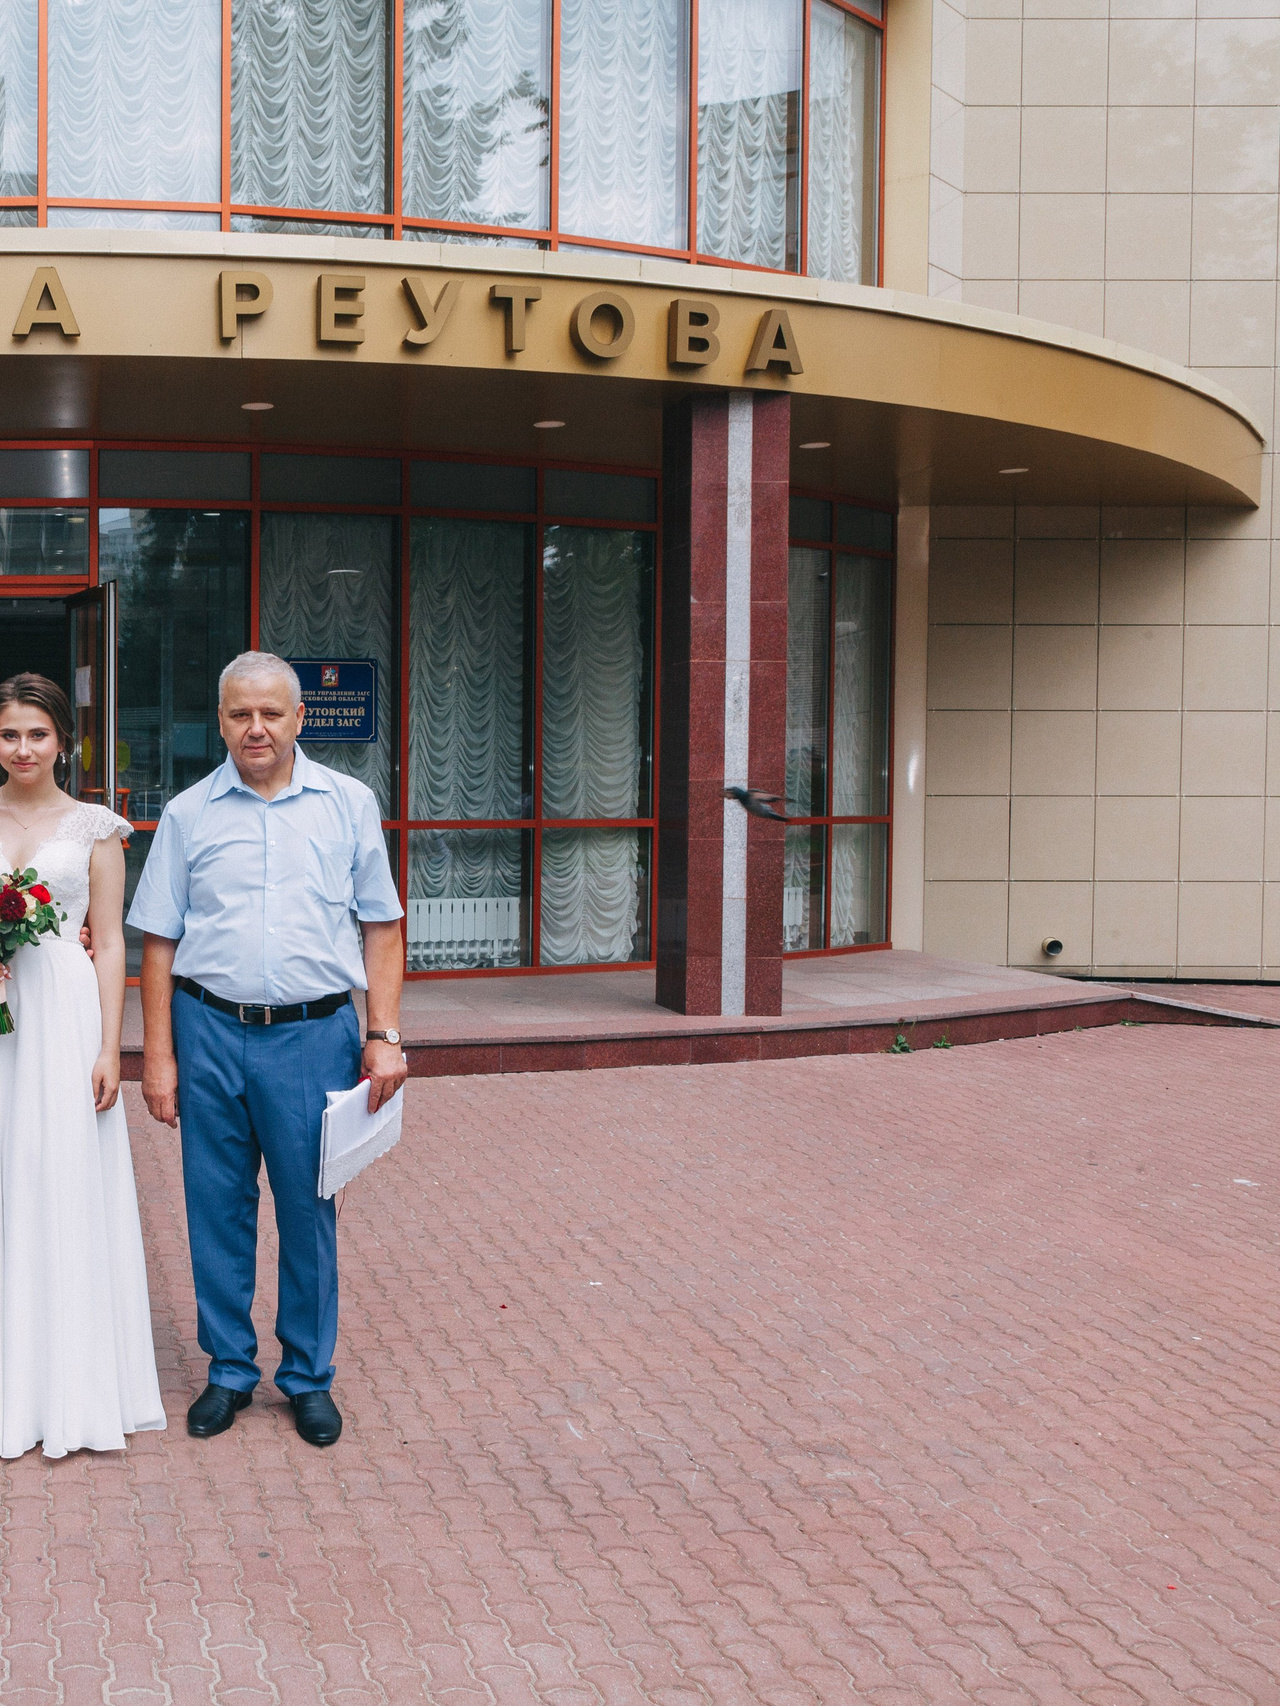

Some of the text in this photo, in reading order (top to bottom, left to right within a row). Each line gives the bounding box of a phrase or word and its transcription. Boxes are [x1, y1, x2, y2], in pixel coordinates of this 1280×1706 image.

[218, 270, 805, 376] РЕУТОВА
[304, 706, 365, 716] ЕУТОВСКИЙ
[336, 718, 361, 726] ЗАГС
